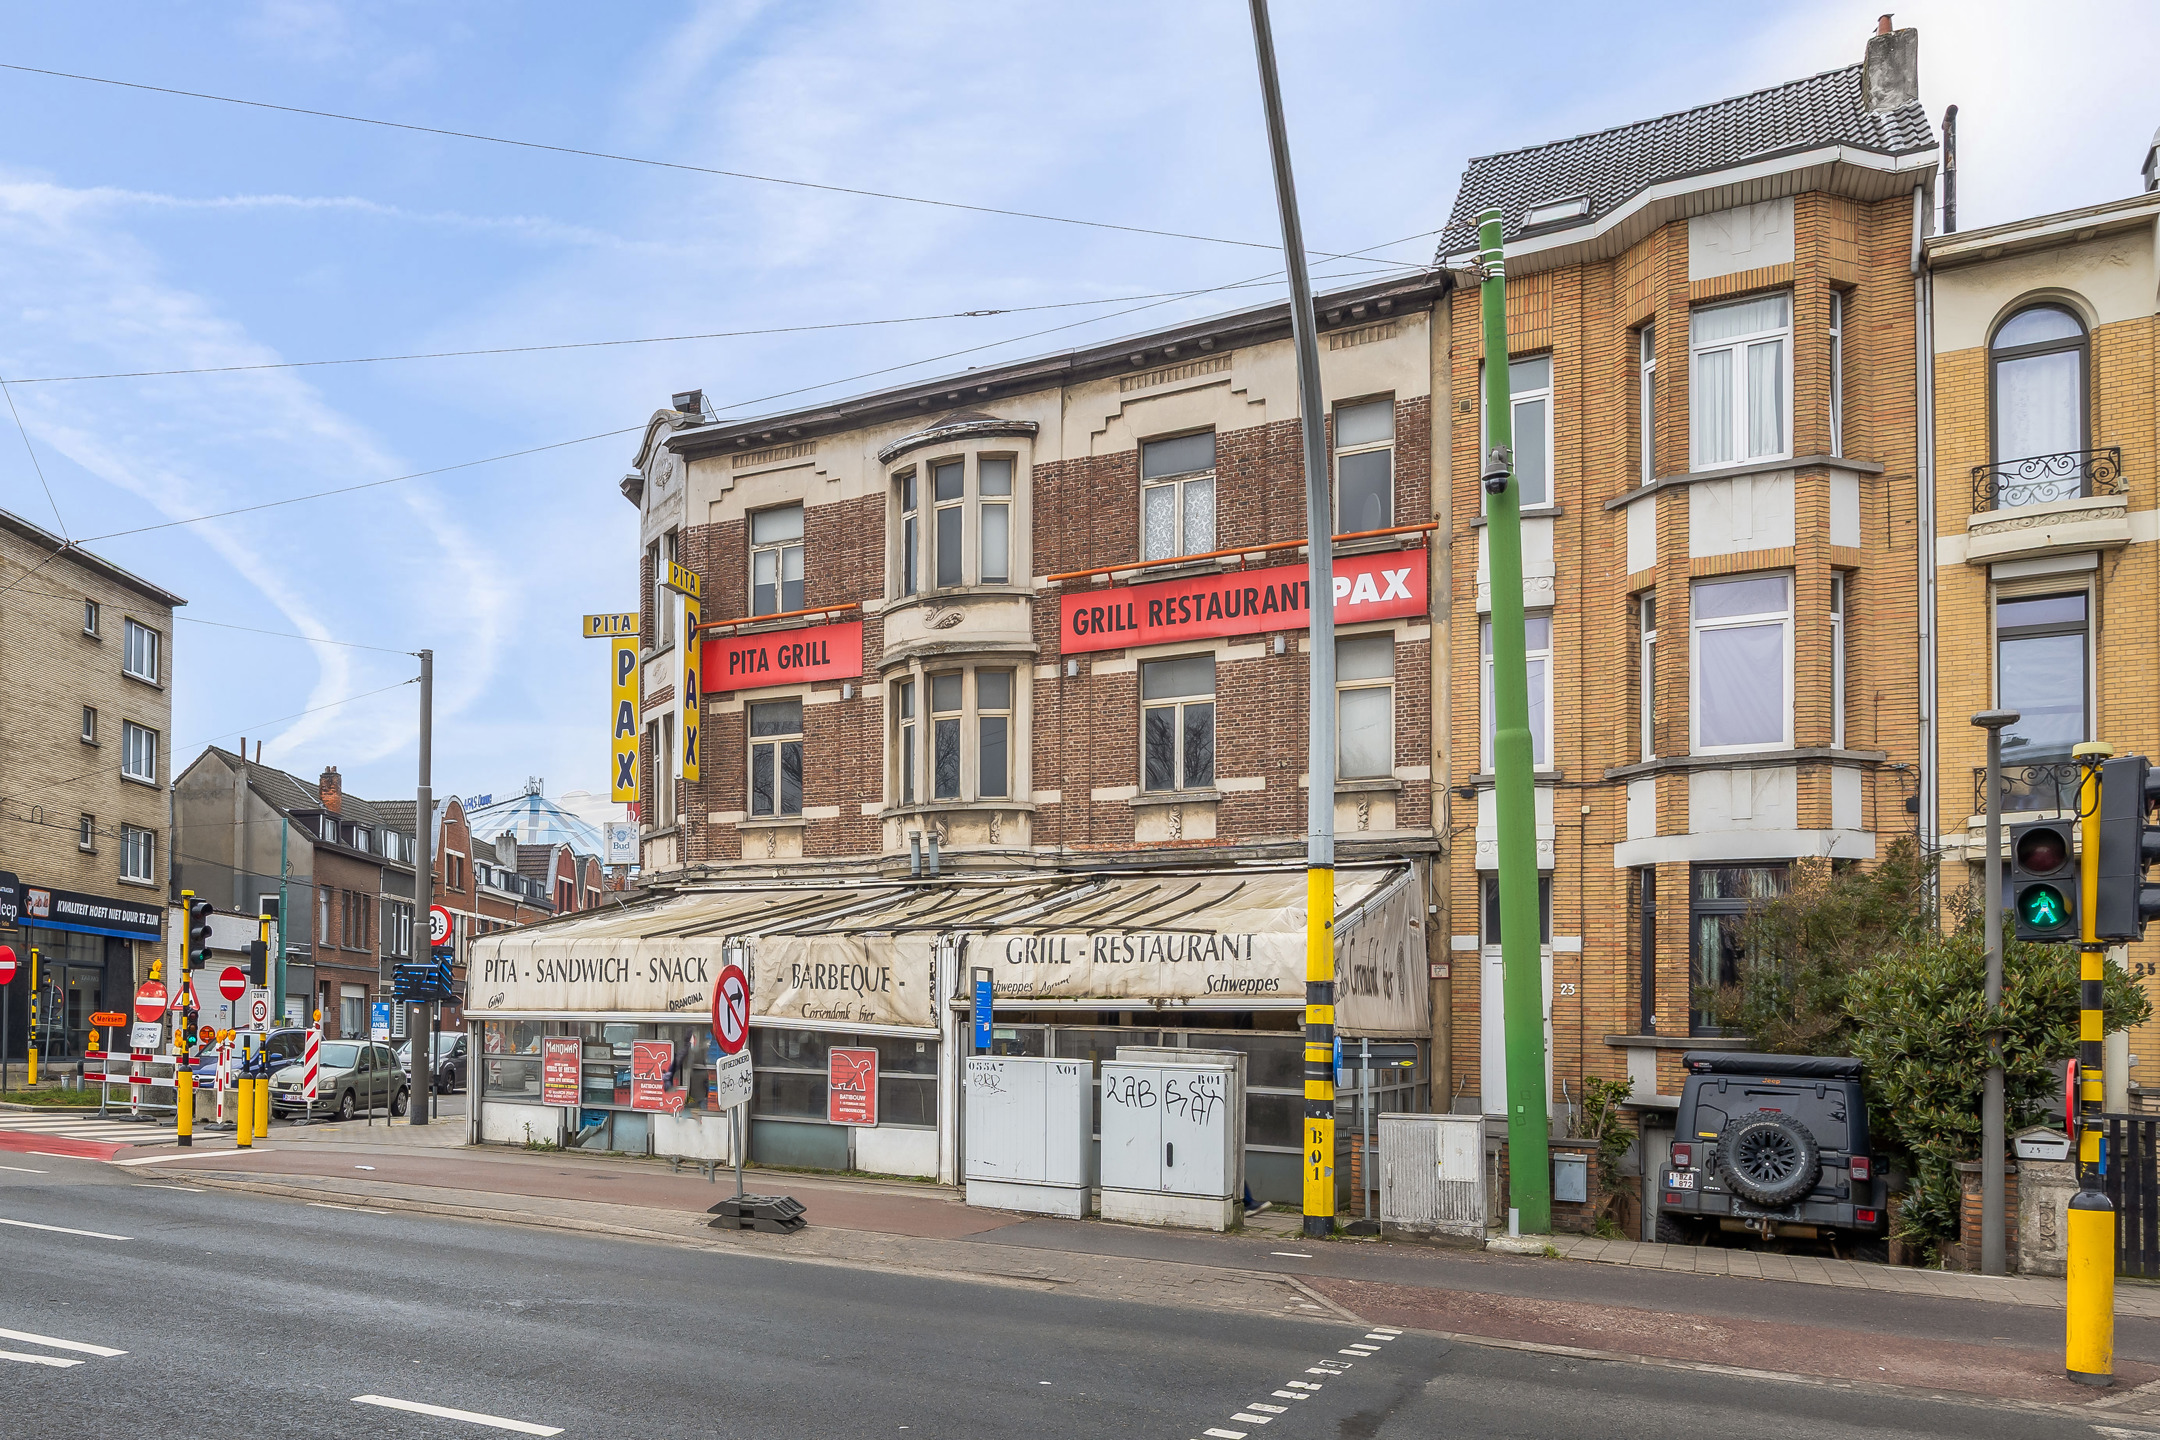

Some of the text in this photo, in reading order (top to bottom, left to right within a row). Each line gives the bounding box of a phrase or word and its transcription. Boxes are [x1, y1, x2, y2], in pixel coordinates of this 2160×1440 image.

[674, 566, 696, 592] PITA
[1073, 567, 1413, 637] GRILL RESTAURANT PAX
[593, 615, 631, 633] PITA
[729, 639, 831, 676] PITA GRILL
[685, 611, 697, 766] PAX
[615, 649, 636, 790] PAX
[613, 842, 630, 850] Bud
[57, 900, 89, 916] KWALITEIT
[89, 905, 108, 919] HOEFT
[108, 908, 122, 921] NIET
[122, 910, 138, 923] DUUR
[139, 912, 146, 924] TE
[146, 914, 159, 926] ZIJN
[1006, 936, 1071, 965] GRILL
[1093, 933, 1257, 963] RESTAURANT
[485, 959, 517, 983] PITA
[536, 957, 628, 983] SANDWICH
[649, 957, 709, 983] SNACK
[2135, 962, 2156, 976] 25
[792, 963, 890, 998] BARBEQUE
[1203, 974, 1280, 996] Schweppes
[1560, 983, 1575, 996] 23
[254, 1007, 264, 1015] 30
[669, 992, 703, 1011] ORANGINA
[801, 1002, 875, 1022] Corsendonk bier
[546, 1041, 578, 1060] MANOWAR
[722, 1054, 750, 1071] UITGEZONDERD
[1056, 1064, 1077, 1076] X01
[1738, 1122, 1780, 1136] DISCOVERER
[1311, 1130, 1323, 1181] B01
[1678, 1180, 1693, 1188] 872
